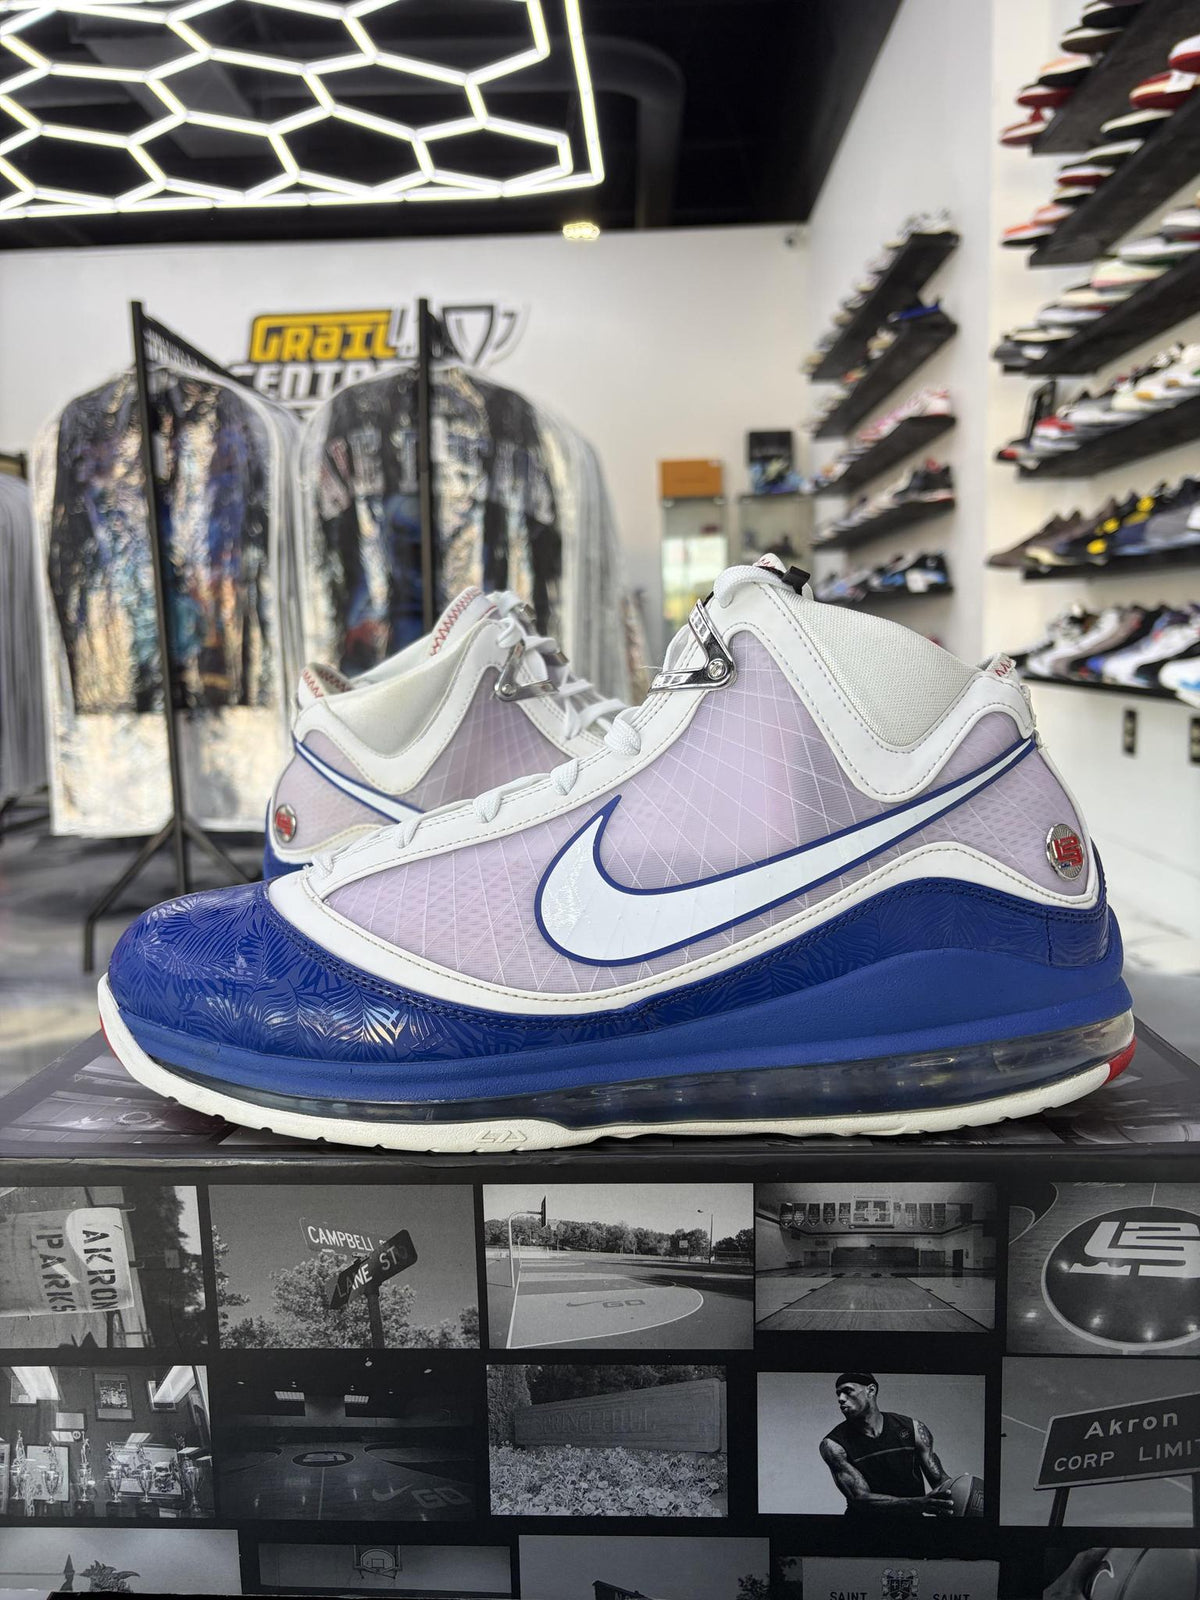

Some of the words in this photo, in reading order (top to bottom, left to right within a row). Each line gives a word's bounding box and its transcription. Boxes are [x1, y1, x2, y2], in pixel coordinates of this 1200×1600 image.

[82, 1229, 119, 1310] AKRON
[379, 1245, 398, 1271] ST
[36, 1233, 77, 1312] PARKS
[1084, 1412, 1179, 1440] Akron
[1053, 1451, 1116, 1472] CORP
